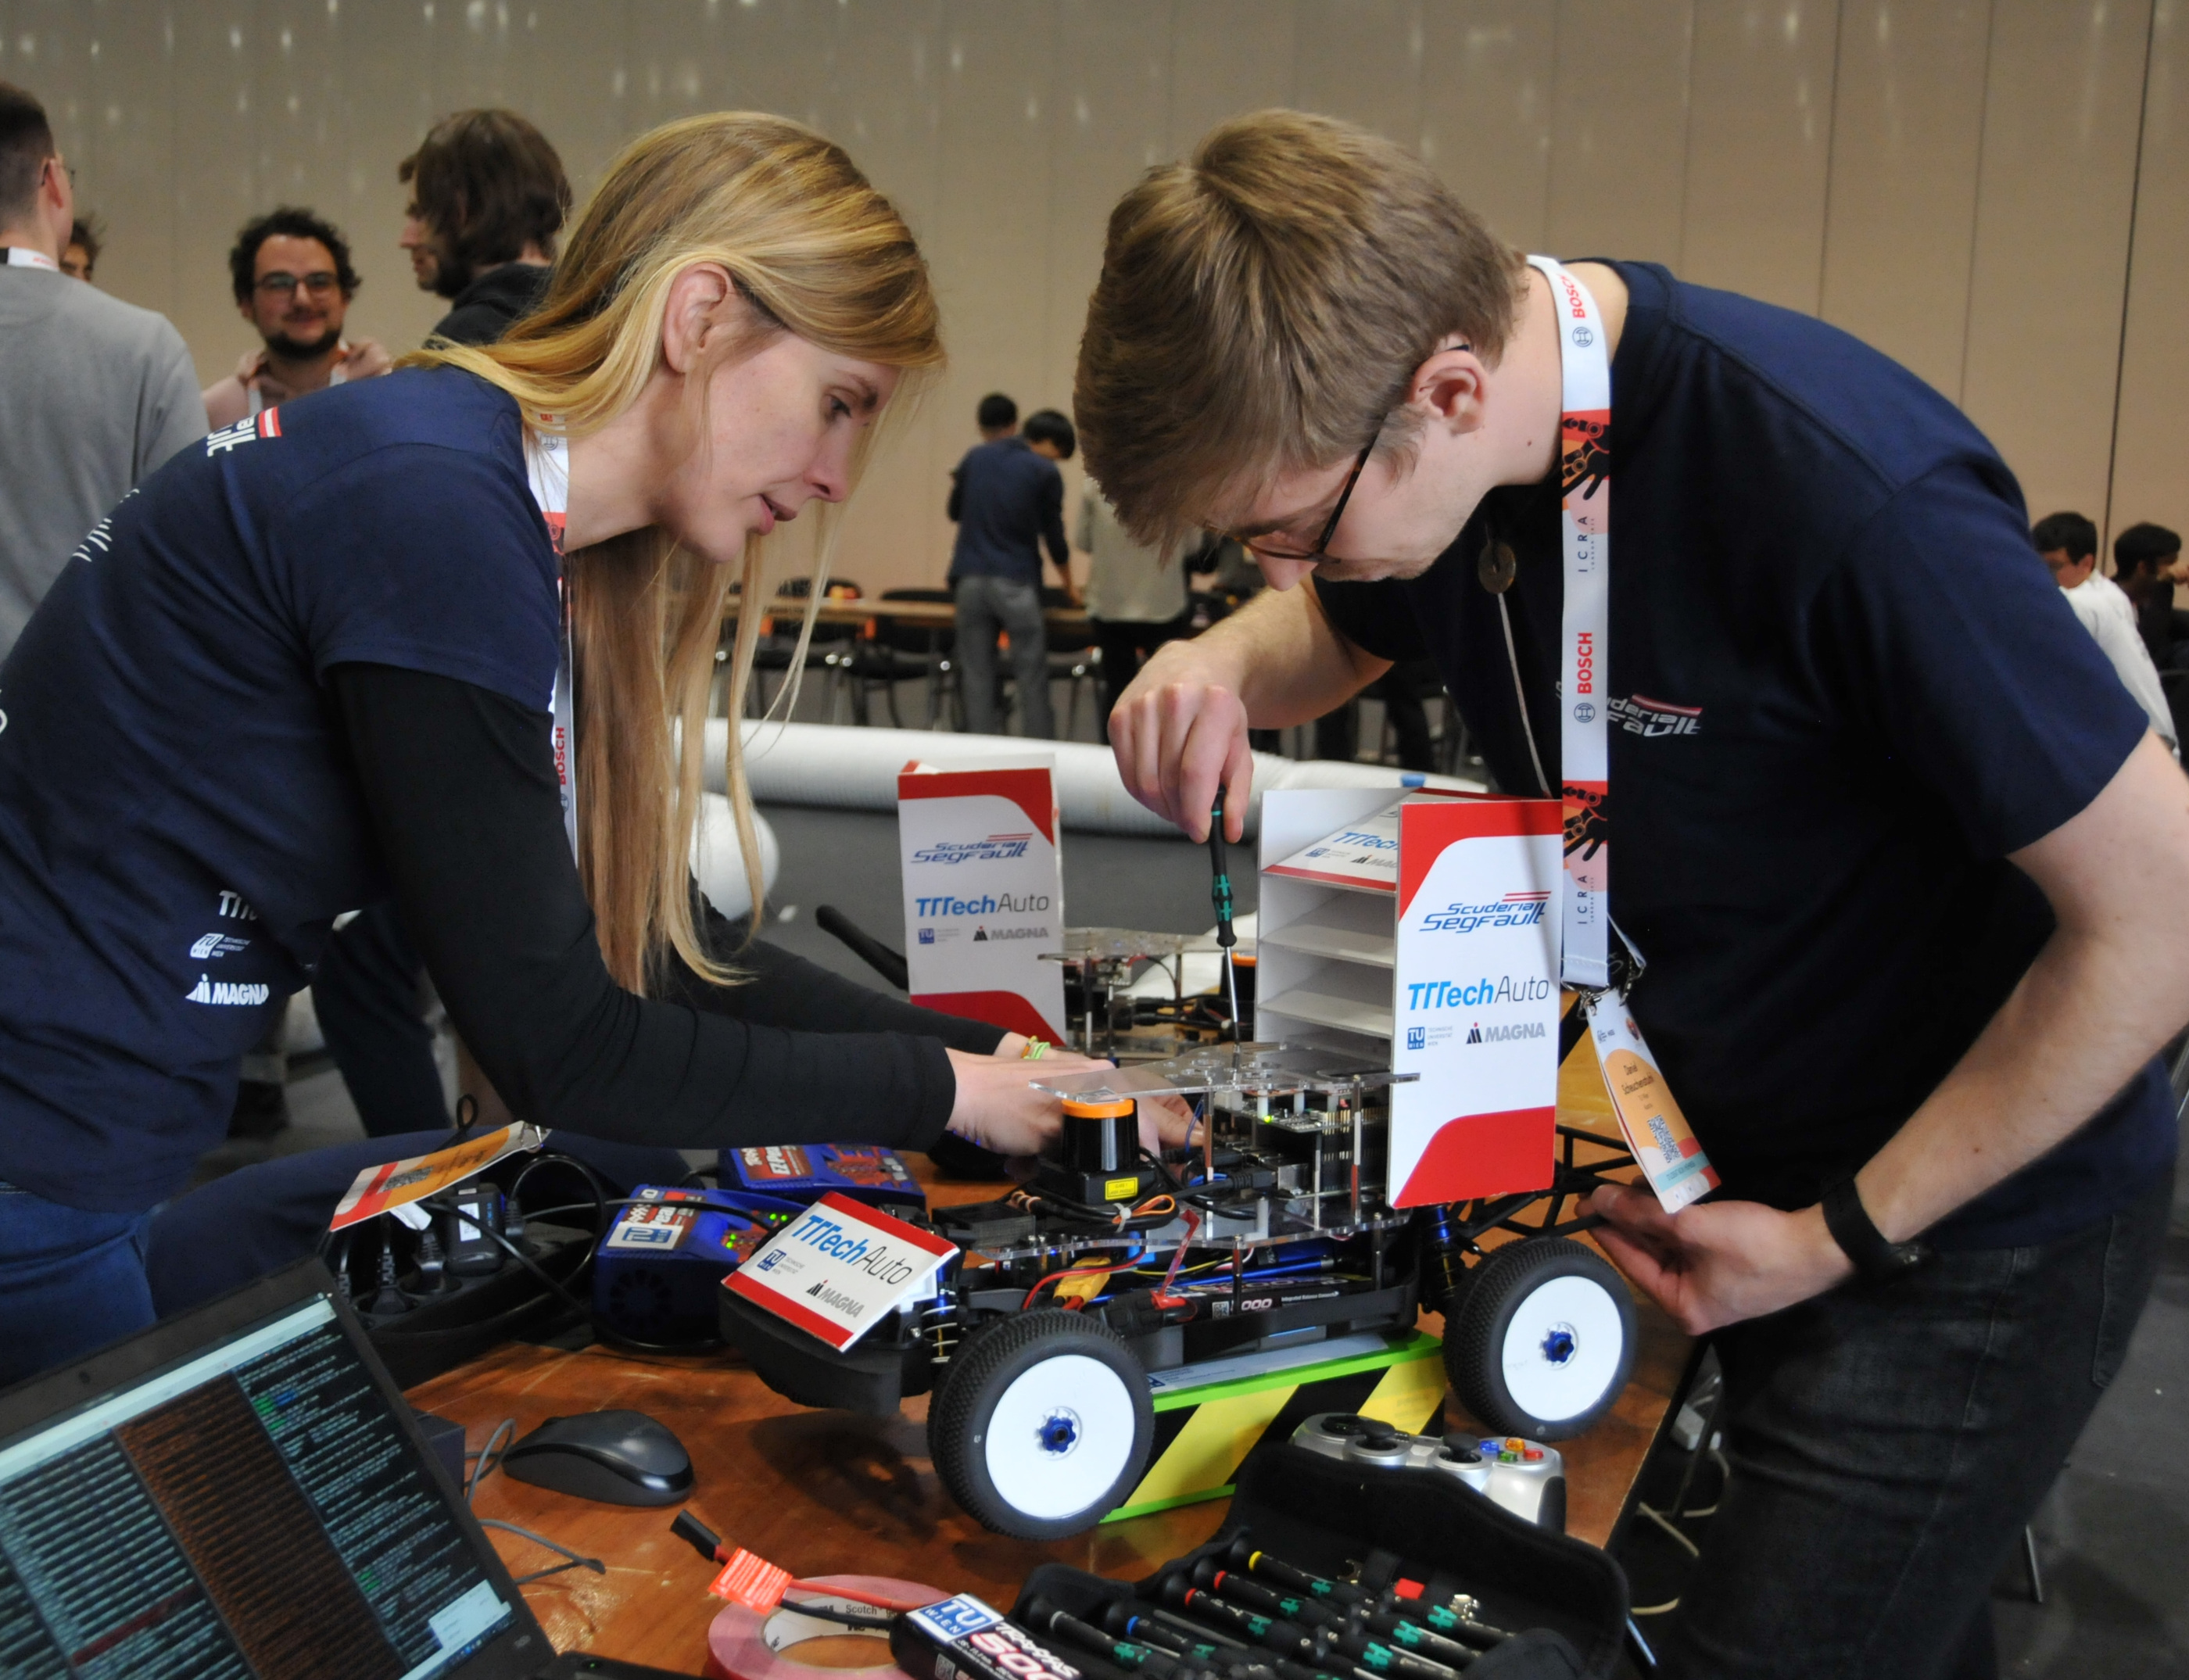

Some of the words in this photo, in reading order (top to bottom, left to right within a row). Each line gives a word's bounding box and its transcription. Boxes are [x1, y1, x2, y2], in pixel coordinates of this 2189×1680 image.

[1578, 516, 1588, 572] ICRA
[1578, 632, 1592, 693] BOSCH
[555, 727, 566, 786] BOSCH
[935, 840, 1017, 851] Scuderia
[1448, 902, 1534, 915] Scuderia
[1578, 876, 1588, 924] ICRA
[991, 927, 1049, 940] MAGNA
[211, 982, 270, 1005] MAGNA
[1408, 1028, 1424, 1041] TU
[1485, 1022, 1546, 1043] MAGNA
[626, 1228, 654, 1241] TU
[766, 1250, 785, 1264] TU
[818, 1288, 865, 1319] MAGNA
[845, 1604, 878, 1616] Scotch
[924, 1608, 962, 1635] WIEN
[940, 1599, 988, 1628] TU
[994, 1622, 1082, 1679] TRAXXAS
